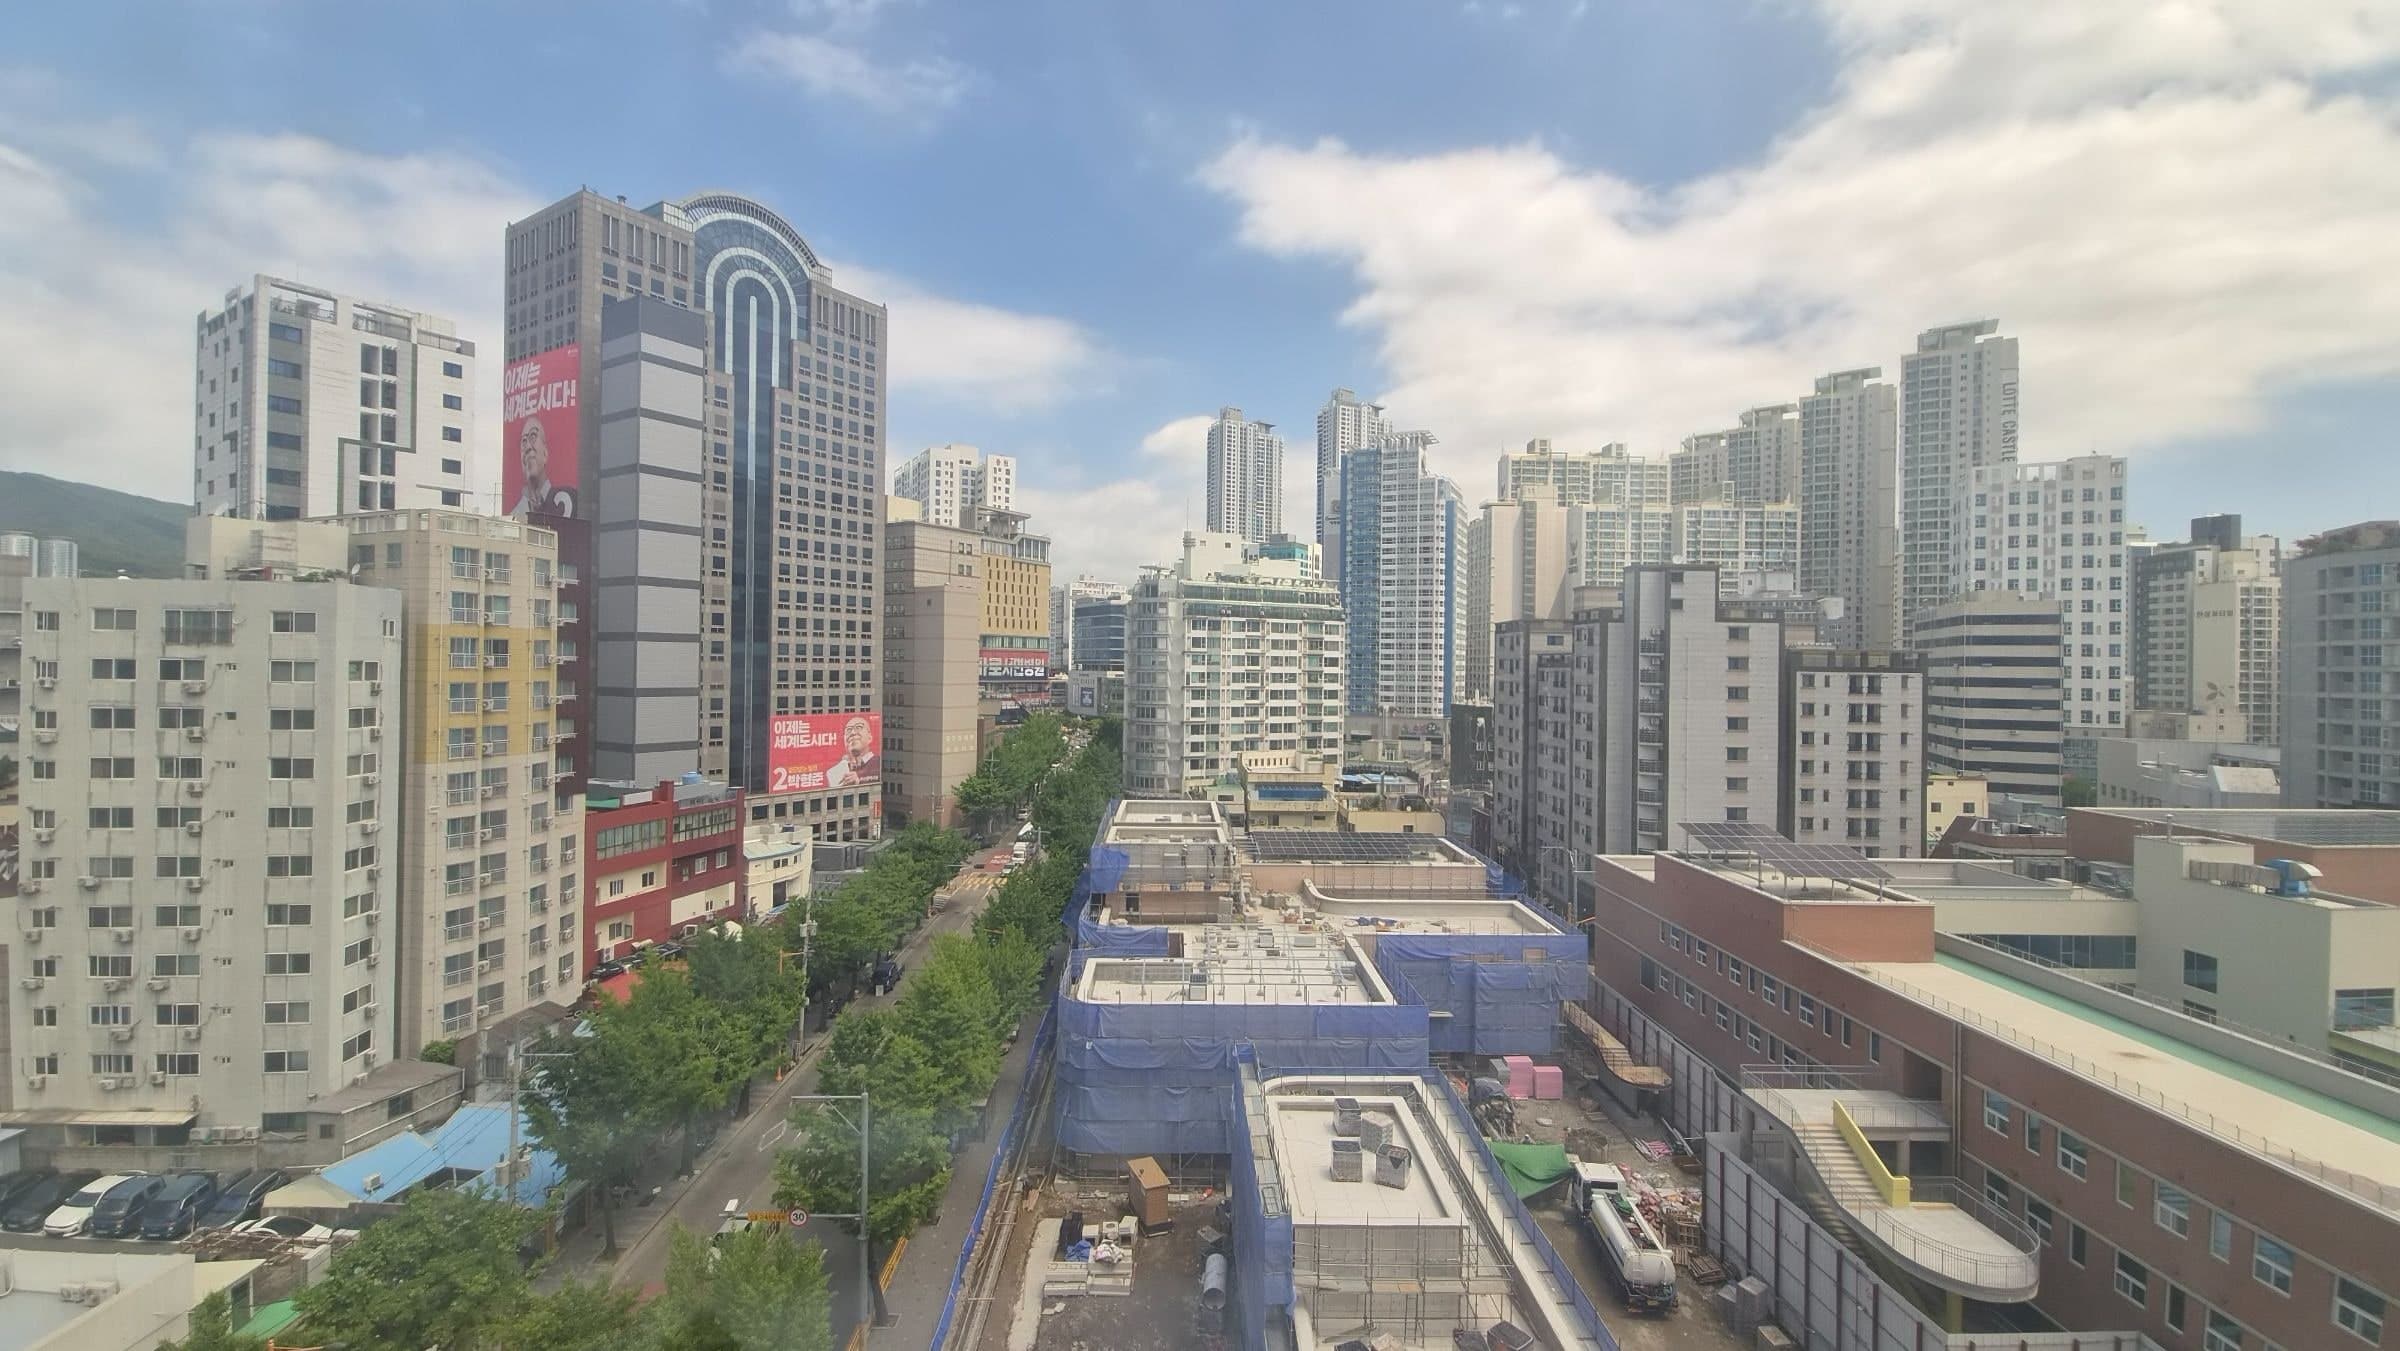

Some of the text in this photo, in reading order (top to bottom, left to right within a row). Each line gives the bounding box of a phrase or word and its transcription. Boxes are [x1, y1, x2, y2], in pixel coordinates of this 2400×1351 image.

[505, 361, 541, 395] 이제는
[504, 379, 576, 423] 세계도시다!
[2001, 382, 2017, 463] LOTTE CASTLE
[774, 720, 811, 735] 이제는
[774, 732, 837, 749] 세계도시다!
[772, 767, 788, 792] 2
[787, 771, 824, 788] 박형준
[792, 1212, 805, 1222] 30
